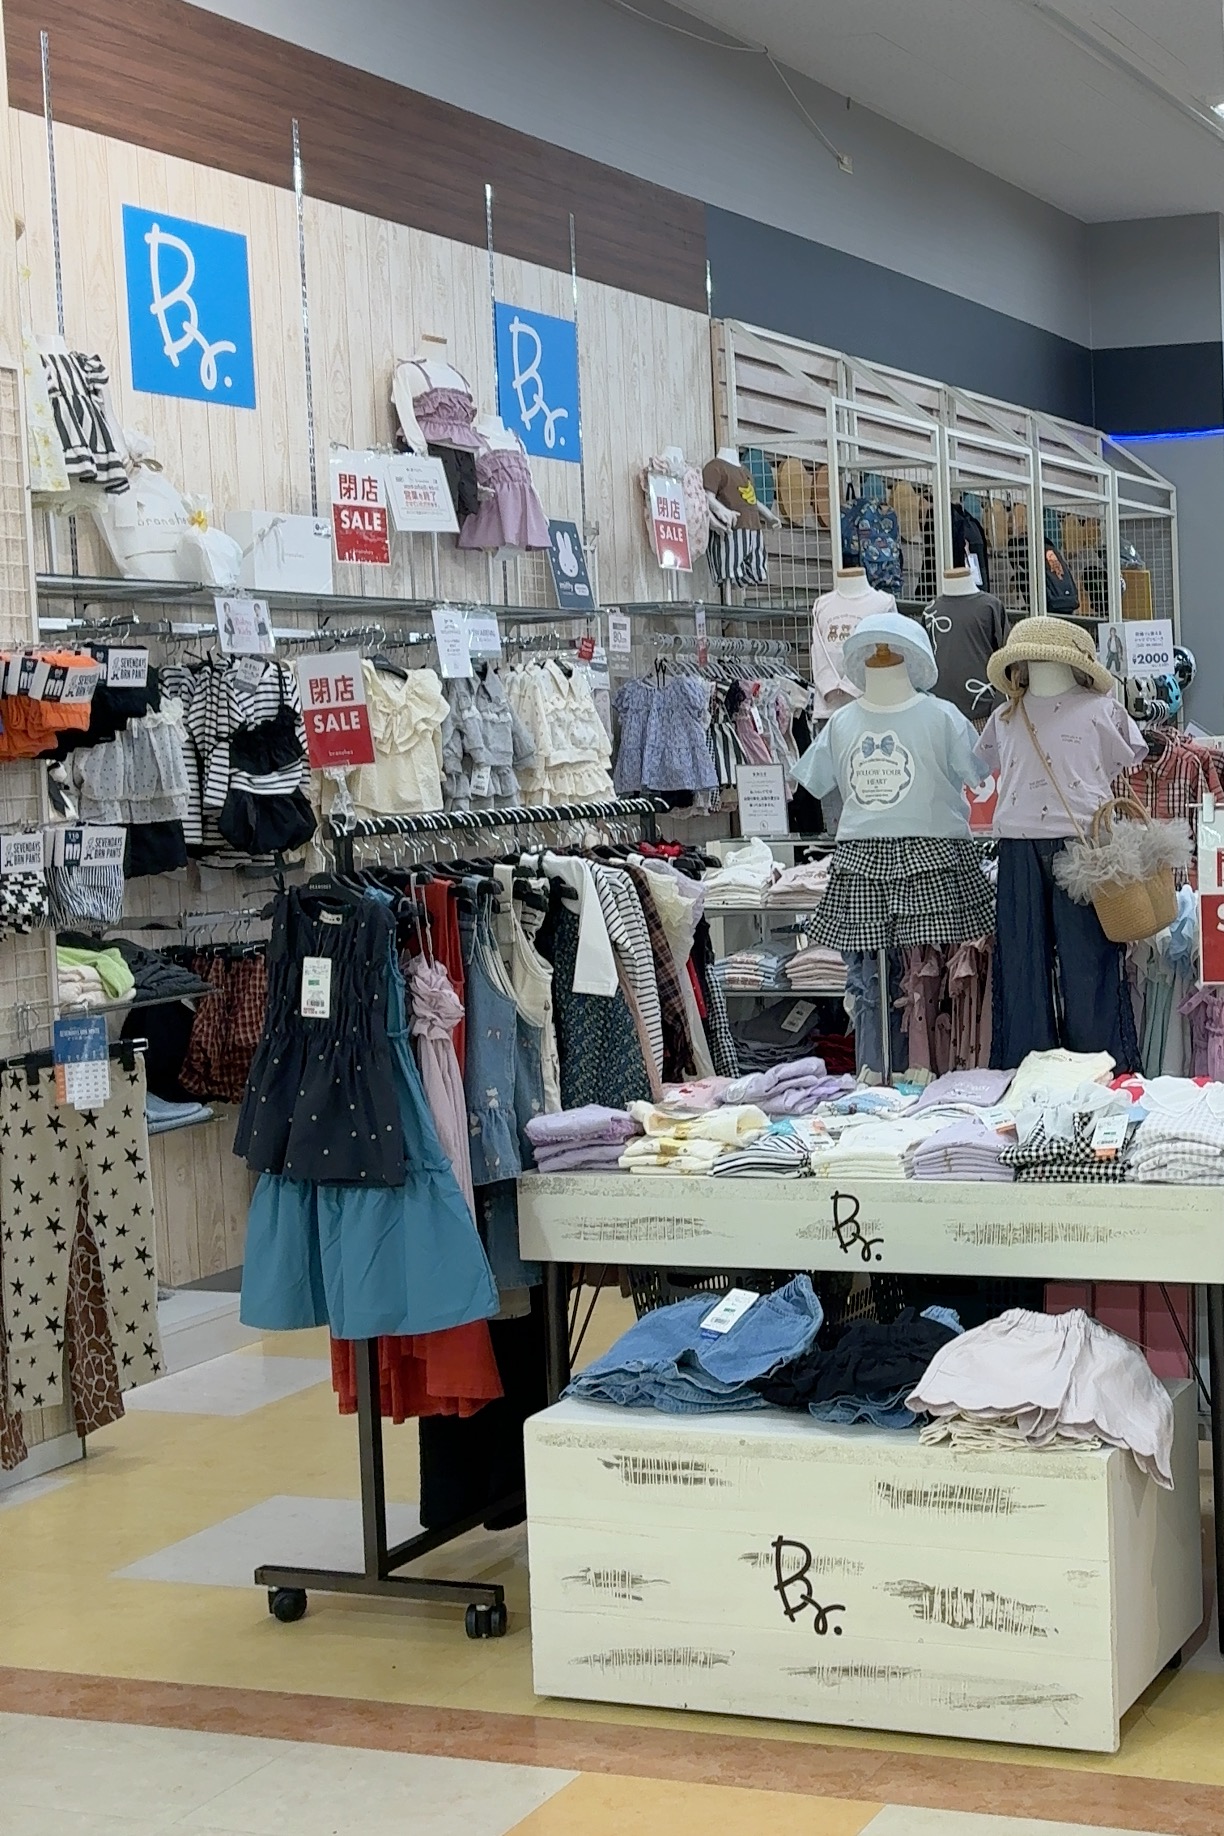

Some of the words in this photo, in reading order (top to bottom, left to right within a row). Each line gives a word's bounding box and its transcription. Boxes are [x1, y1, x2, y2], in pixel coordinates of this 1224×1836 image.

[338, 472, 378, 502] 閉店
[657, 496, 681, 520] 閉店
[340, 509, 382, 531] SALE
[659, 524, 684, 542] SALE
[309, 674, 355, 704] 閉店
[313, 711, 361, 734] SALE
